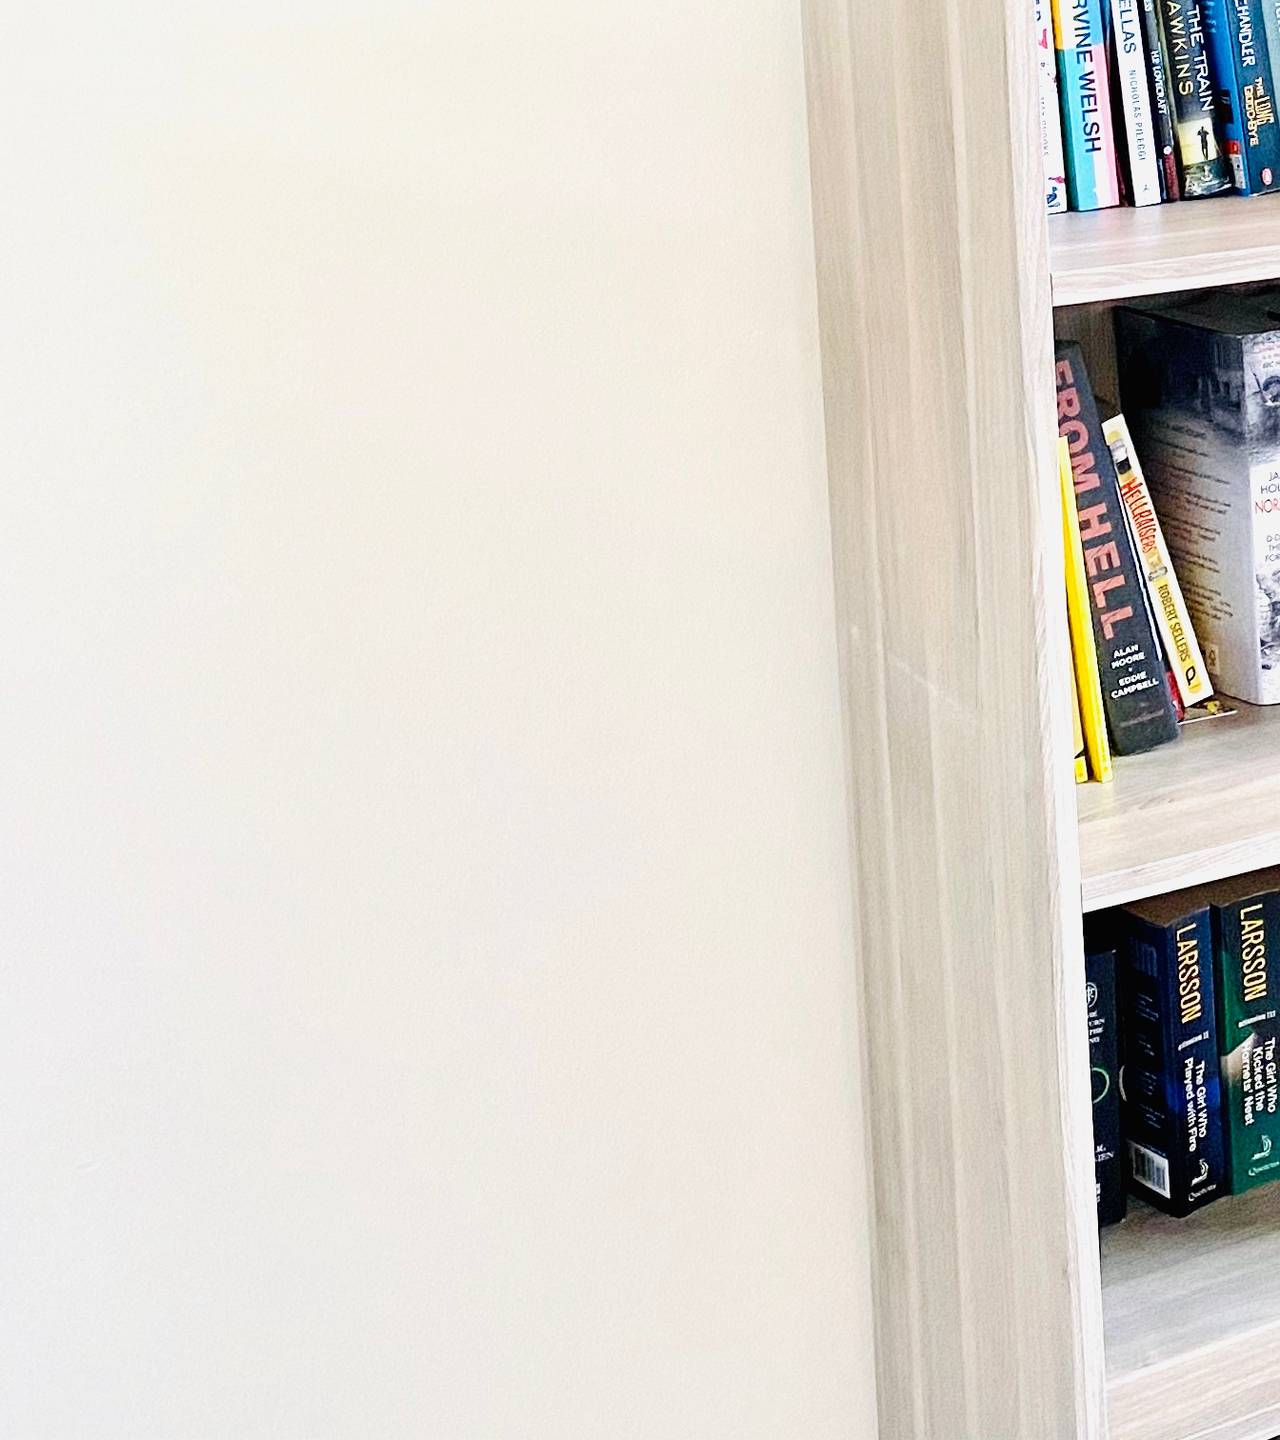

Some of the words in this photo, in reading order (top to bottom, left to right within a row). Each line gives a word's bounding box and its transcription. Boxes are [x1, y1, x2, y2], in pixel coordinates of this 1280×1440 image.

[1187, 4, 1204, 47] THE
[1193, 50, 1214, 111] TRAIN
[1078, 71, 1102, 154] WELSH
[1078, 502, 1134, 641] HELL
[1157, 584, 1178, 622] ROBERT
[1168, 620, 1191, 662] SELLERS
[1111, 652, 1146, 670] MOORE
[1113, 643, 1140, 659] ALAN
[1110, 679, 1160, 700] CAMPBELL
[1118, 670, 1148, 687] EDDIE
[1240, 903, 1268, 1002] LARSSON
[1176, 922, 1202, 1024] LARSSON
[1265, 1036, 1276, 1061] The
[1183, 1057, 1196, 1100] Played
[1195, 1060, 1206, 1085] The
[1252, 1046, 1265, 1090] Kicked
[1266, 1061, 1277, 1084] Girl
[1196, 1086, 1207, 1109] Girl
[1243, 1097, 1255, 1126] Nest
[1254, 1090, 1266, 1112] the
[1267, 1084, 1279, 1113] Who
[1186, 1101, 1197, 1126] with
[1197, 1109, 1207, 1138] Who
[1188, 1127, 1199, 1152] Fire
